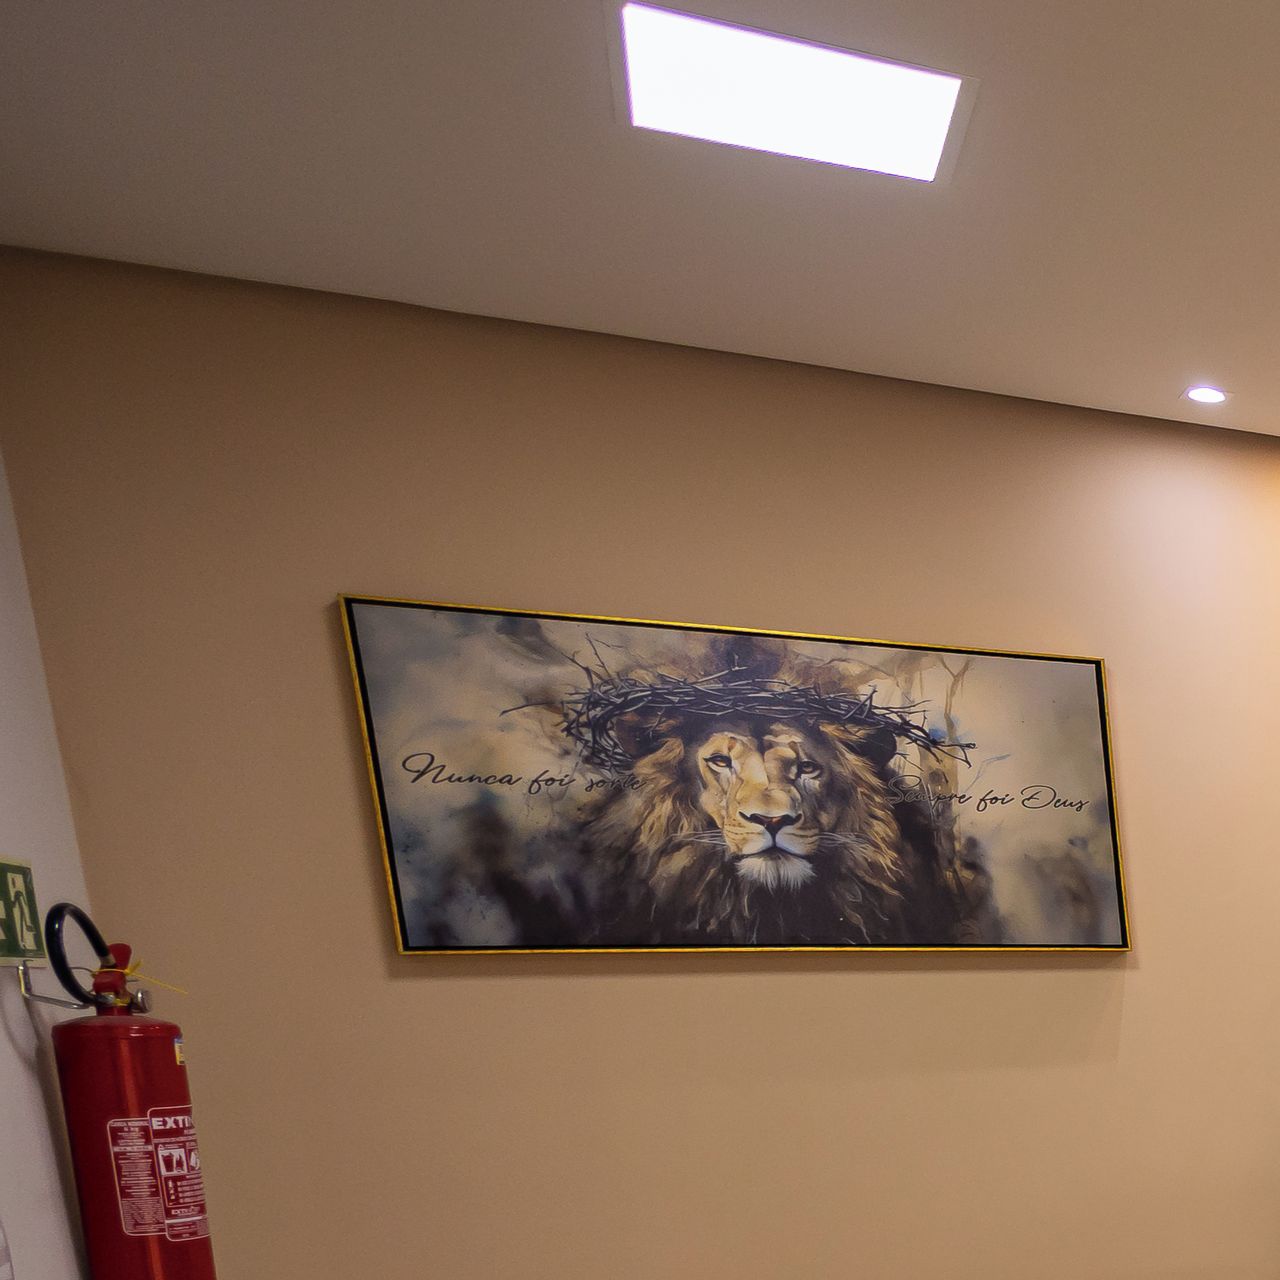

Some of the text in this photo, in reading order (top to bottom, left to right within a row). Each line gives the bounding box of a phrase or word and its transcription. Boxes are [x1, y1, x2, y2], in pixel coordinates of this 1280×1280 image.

[402, 752, 648, 795] Nunca foi sorte
[976, 789, 1015, 812] foi
[1020, 784, 1090, 812] Deus
